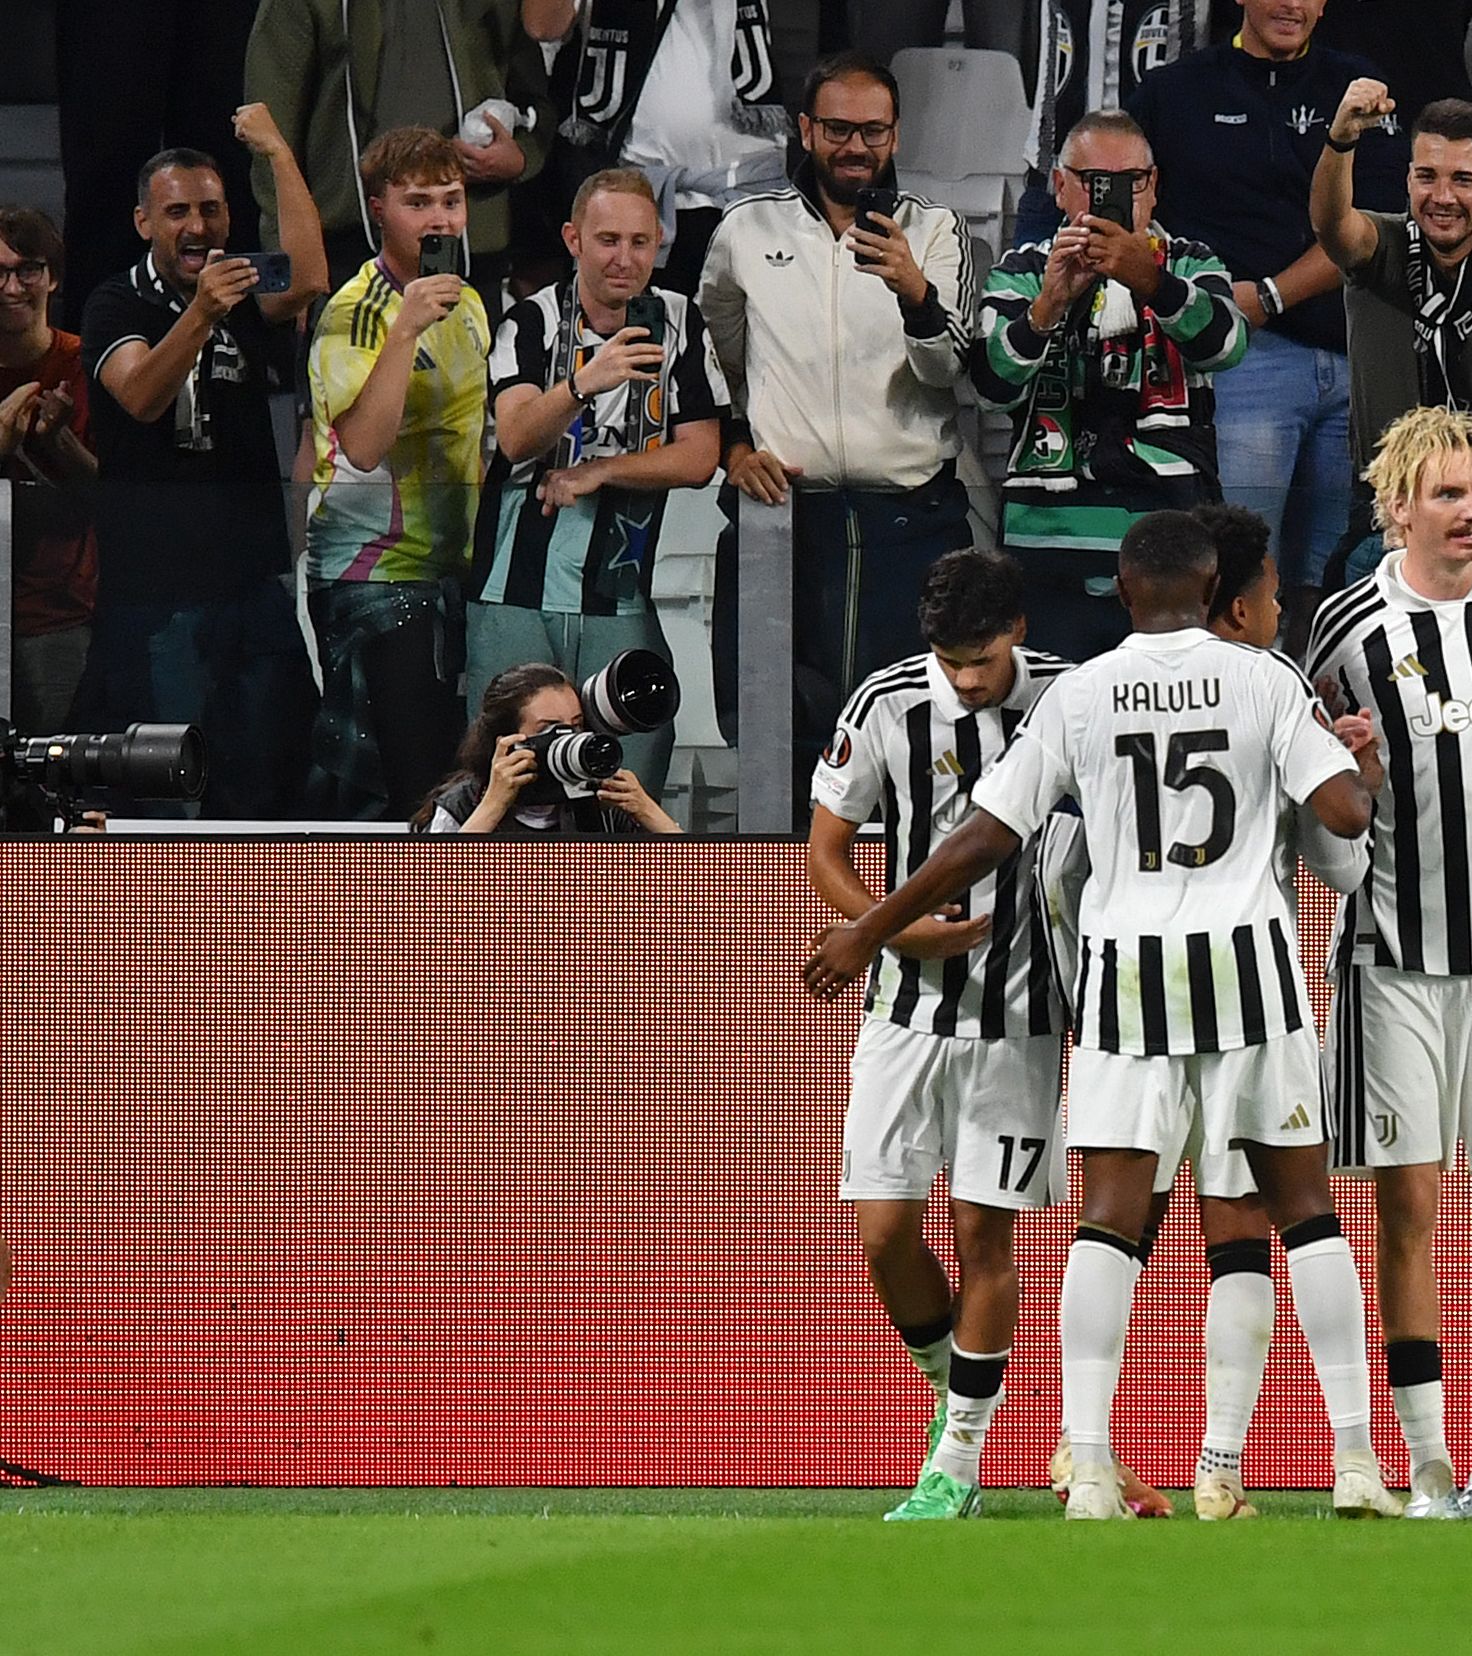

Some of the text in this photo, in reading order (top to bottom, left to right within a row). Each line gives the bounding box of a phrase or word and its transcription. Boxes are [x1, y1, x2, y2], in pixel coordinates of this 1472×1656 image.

[1112, 677, 1221, 714] KALULU
[1114, 728, 1237, 873] 15
[998, 1135, 1047, 1193] 17
